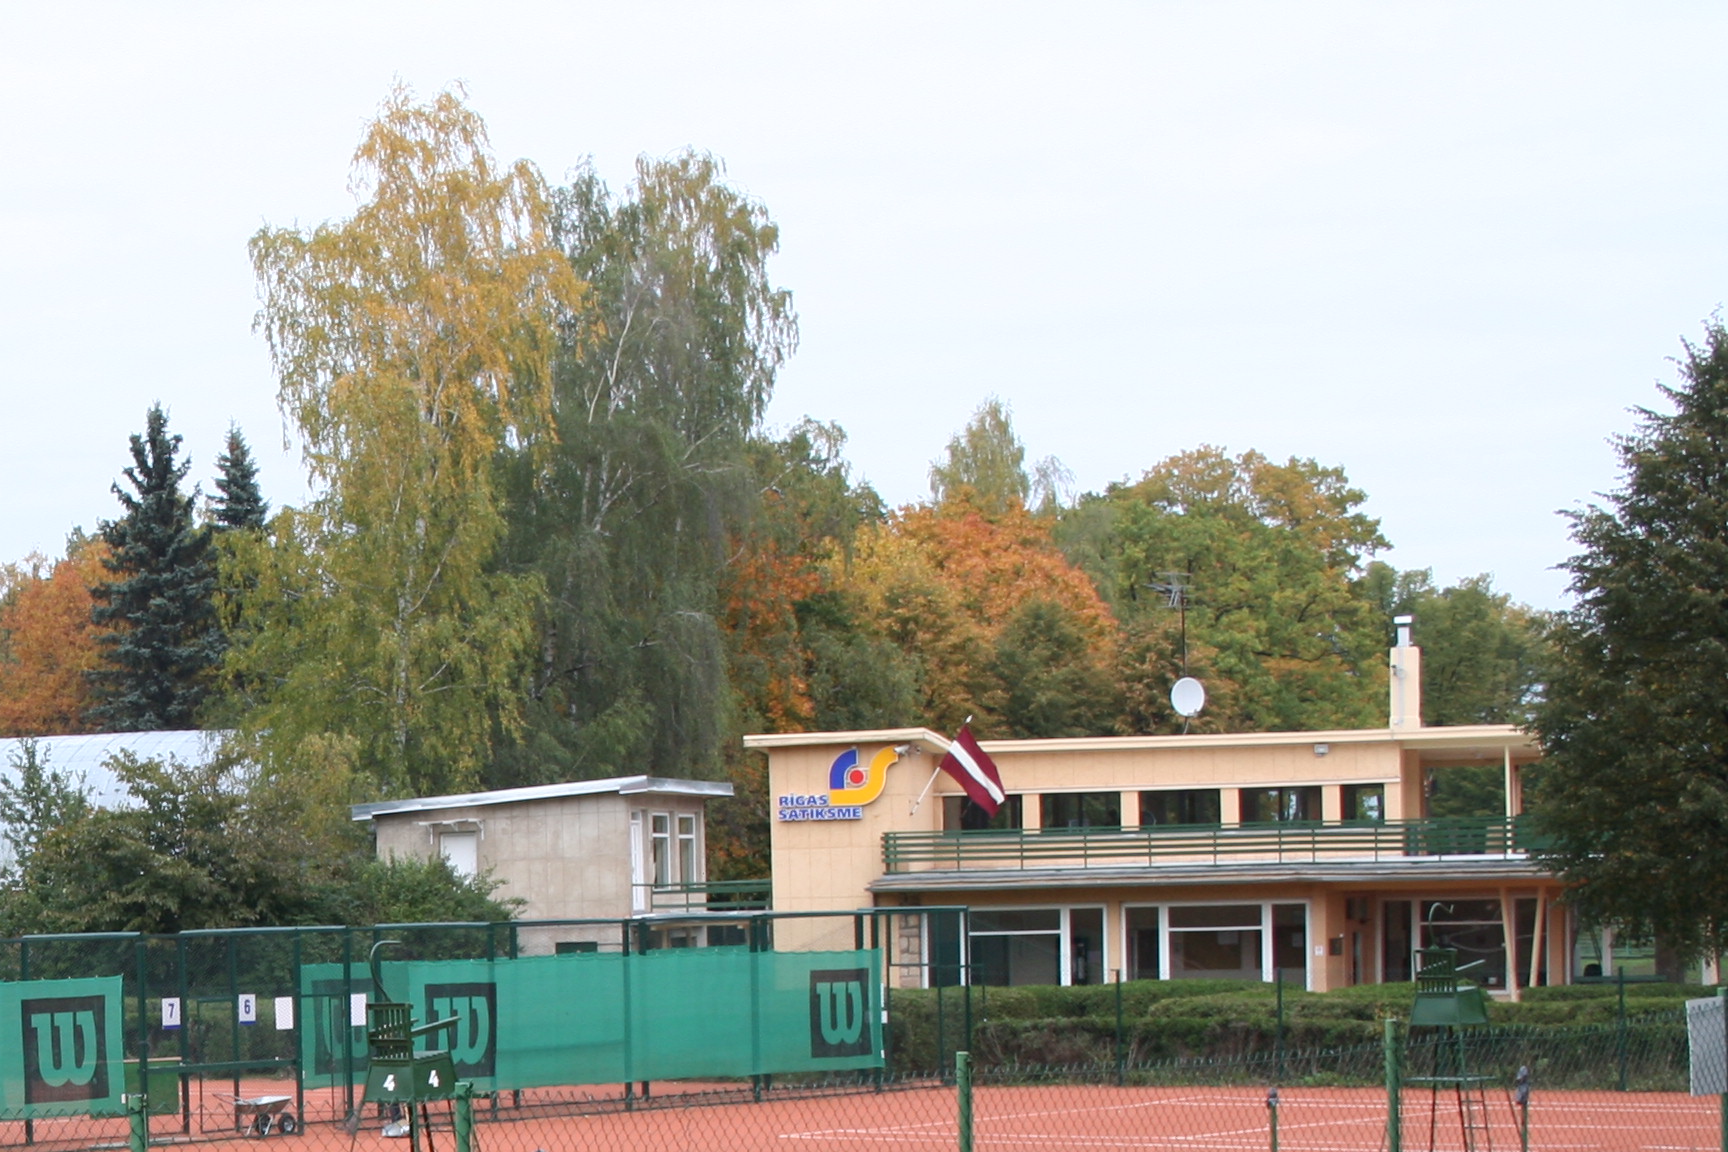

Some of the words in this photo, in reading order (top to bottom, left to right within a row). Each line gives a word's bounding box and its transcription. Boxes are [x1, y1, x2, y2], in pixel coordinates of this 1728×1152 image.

[778, 807, 862, 819] SATIKSME
[168, 1003, 175, 1019] 7
[244, 1000, 251, 1015] 6
[383, 1074, 396, 1091] 4
[428, 1069, 440, 1088] 4
